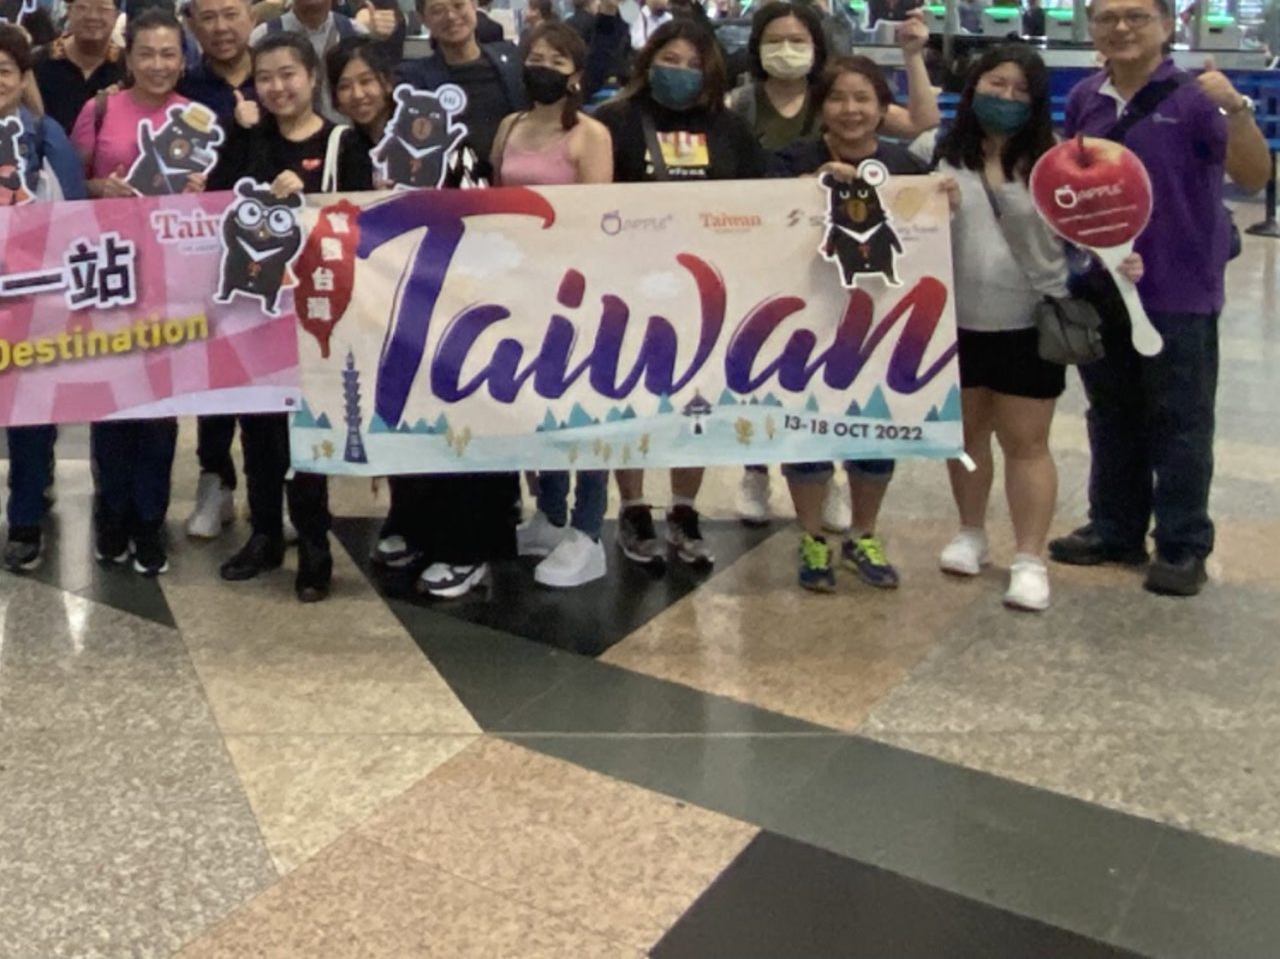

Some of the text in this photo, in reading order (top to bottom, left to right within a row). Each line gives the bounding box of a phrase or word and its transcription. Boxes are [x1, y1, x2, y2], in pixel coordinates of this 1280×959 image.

[153, 211, 221, 240] Taiw
[699, 212, 763, 228] Taiwan
[356, 186, 958, 430] Taiwan
[783, 414, 923, 441] 13-18 OCT 2022
